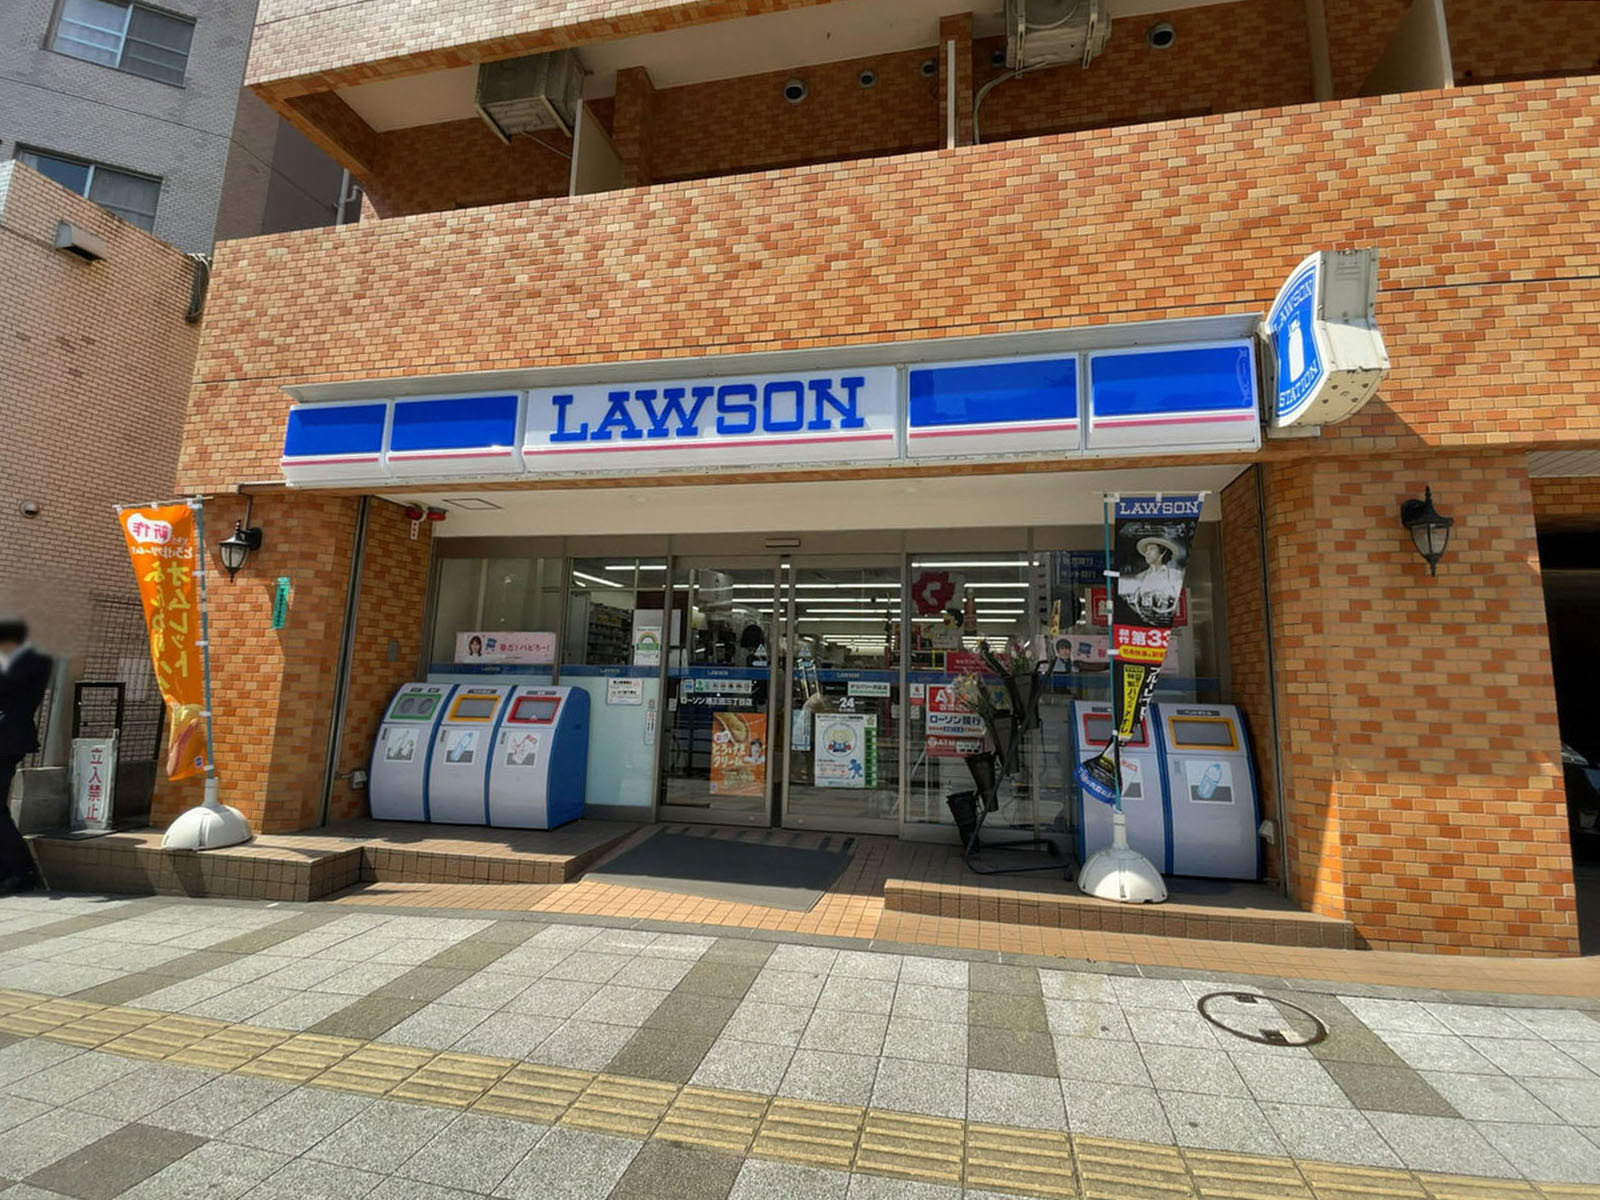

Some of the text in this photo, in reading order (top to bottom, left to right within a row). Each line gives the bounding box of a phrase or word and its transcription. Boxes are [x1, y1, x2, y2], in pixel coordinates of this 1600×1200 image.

[1273, 279, 1314, 332] LAWSON
[1279, 360, 1319, 407] STATION
[549, 376, 865, 442] LAWSON
[1119, 502, 1199, 515] LAWSON
[839, 697, 855, 708] 24
[929, 715, 981, 726] ローソン銀行
[84, 747, 104, 822] 立入禁止
